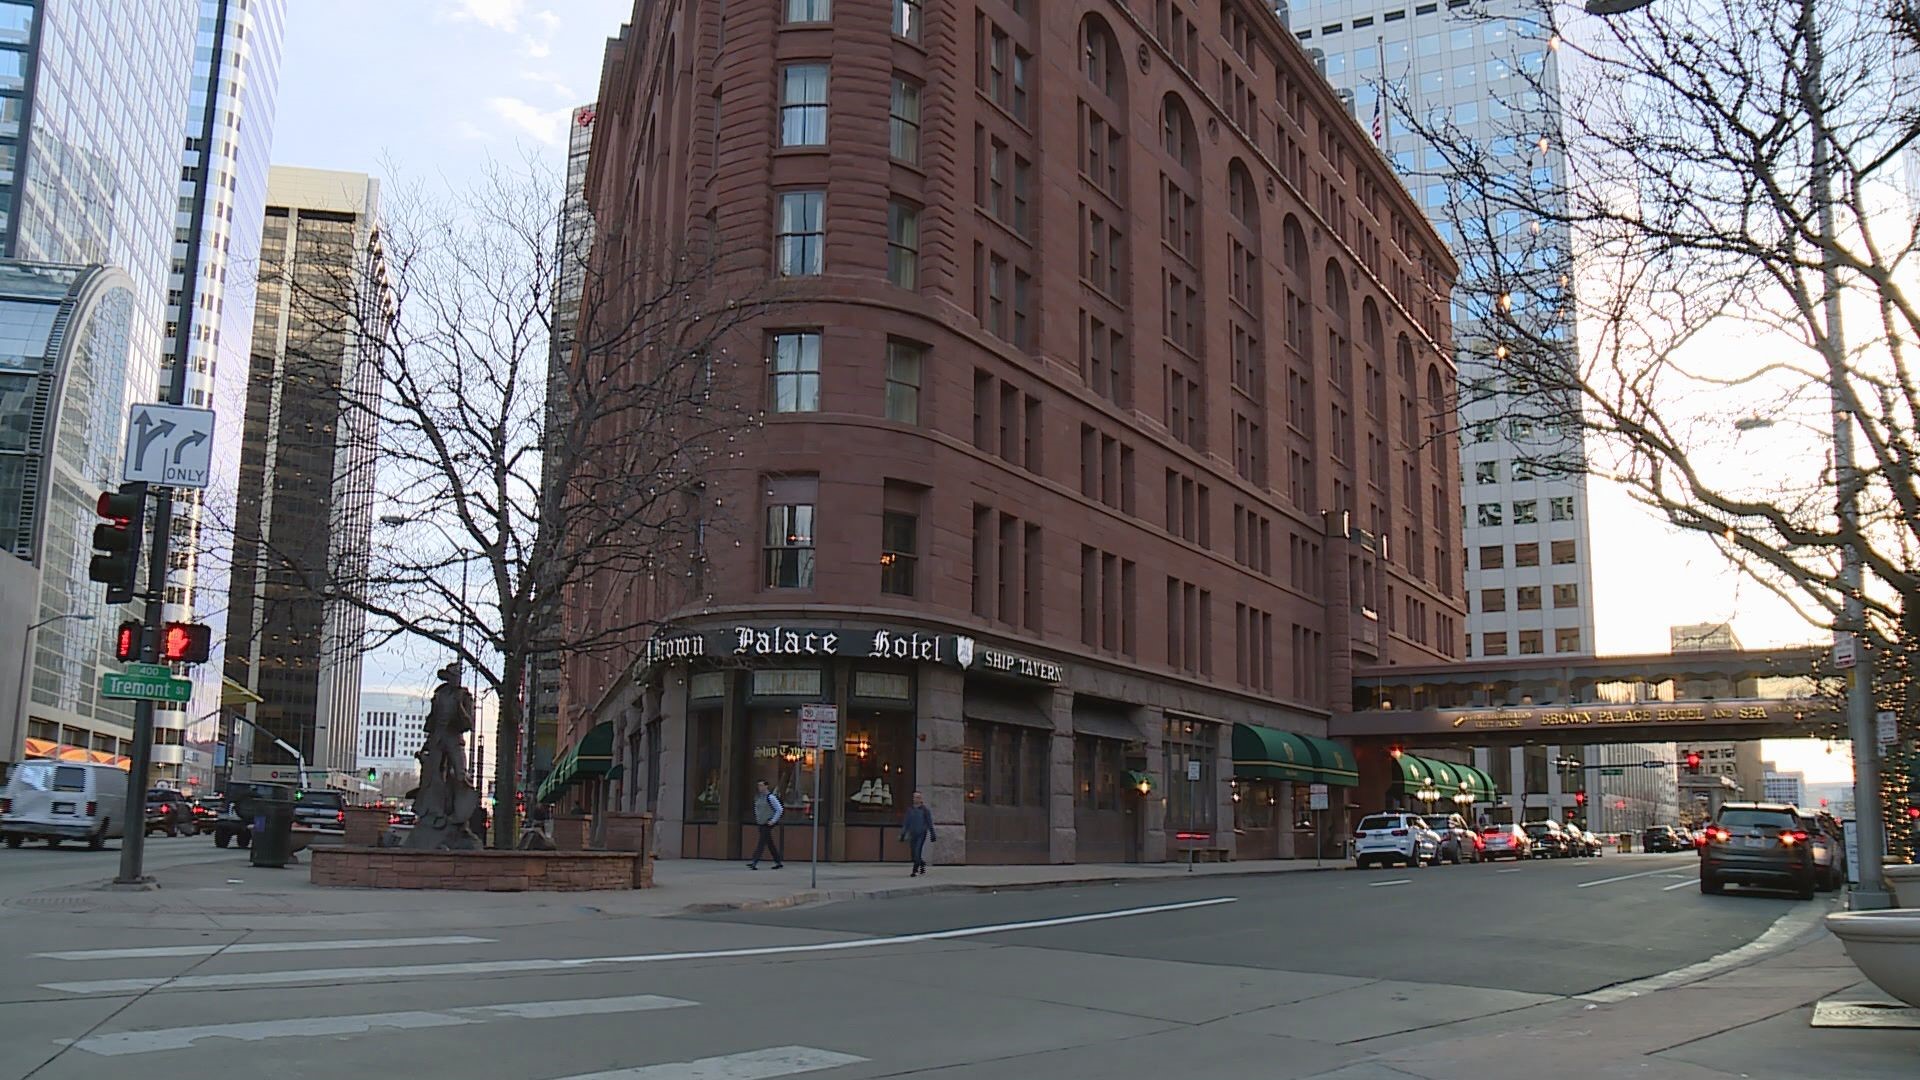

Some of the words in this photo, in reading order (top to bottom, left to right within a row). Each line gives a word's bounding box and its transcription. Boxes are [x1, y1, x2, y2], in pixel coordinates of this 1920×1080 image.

[167, 467, 205, 481] ONLY
[733, 625, 838, 654] Palace
[869, 629, 942, 662] Hotel
[140, 667, 159, 676] 400
[985, 651, 1014, 671] SHIP
[1019, 658, 1063, 682] TAVERN
[110, 677, 170, 697] Tremont
[1541, 711, 1592, 725] BROWN
[1597, 710, 1652, 723] PALACE
[1656, 707, 1706, 721] HOTEL
[1711, 709, 1734, 718] AND
[1739, 706, 1768, 719] SPA
